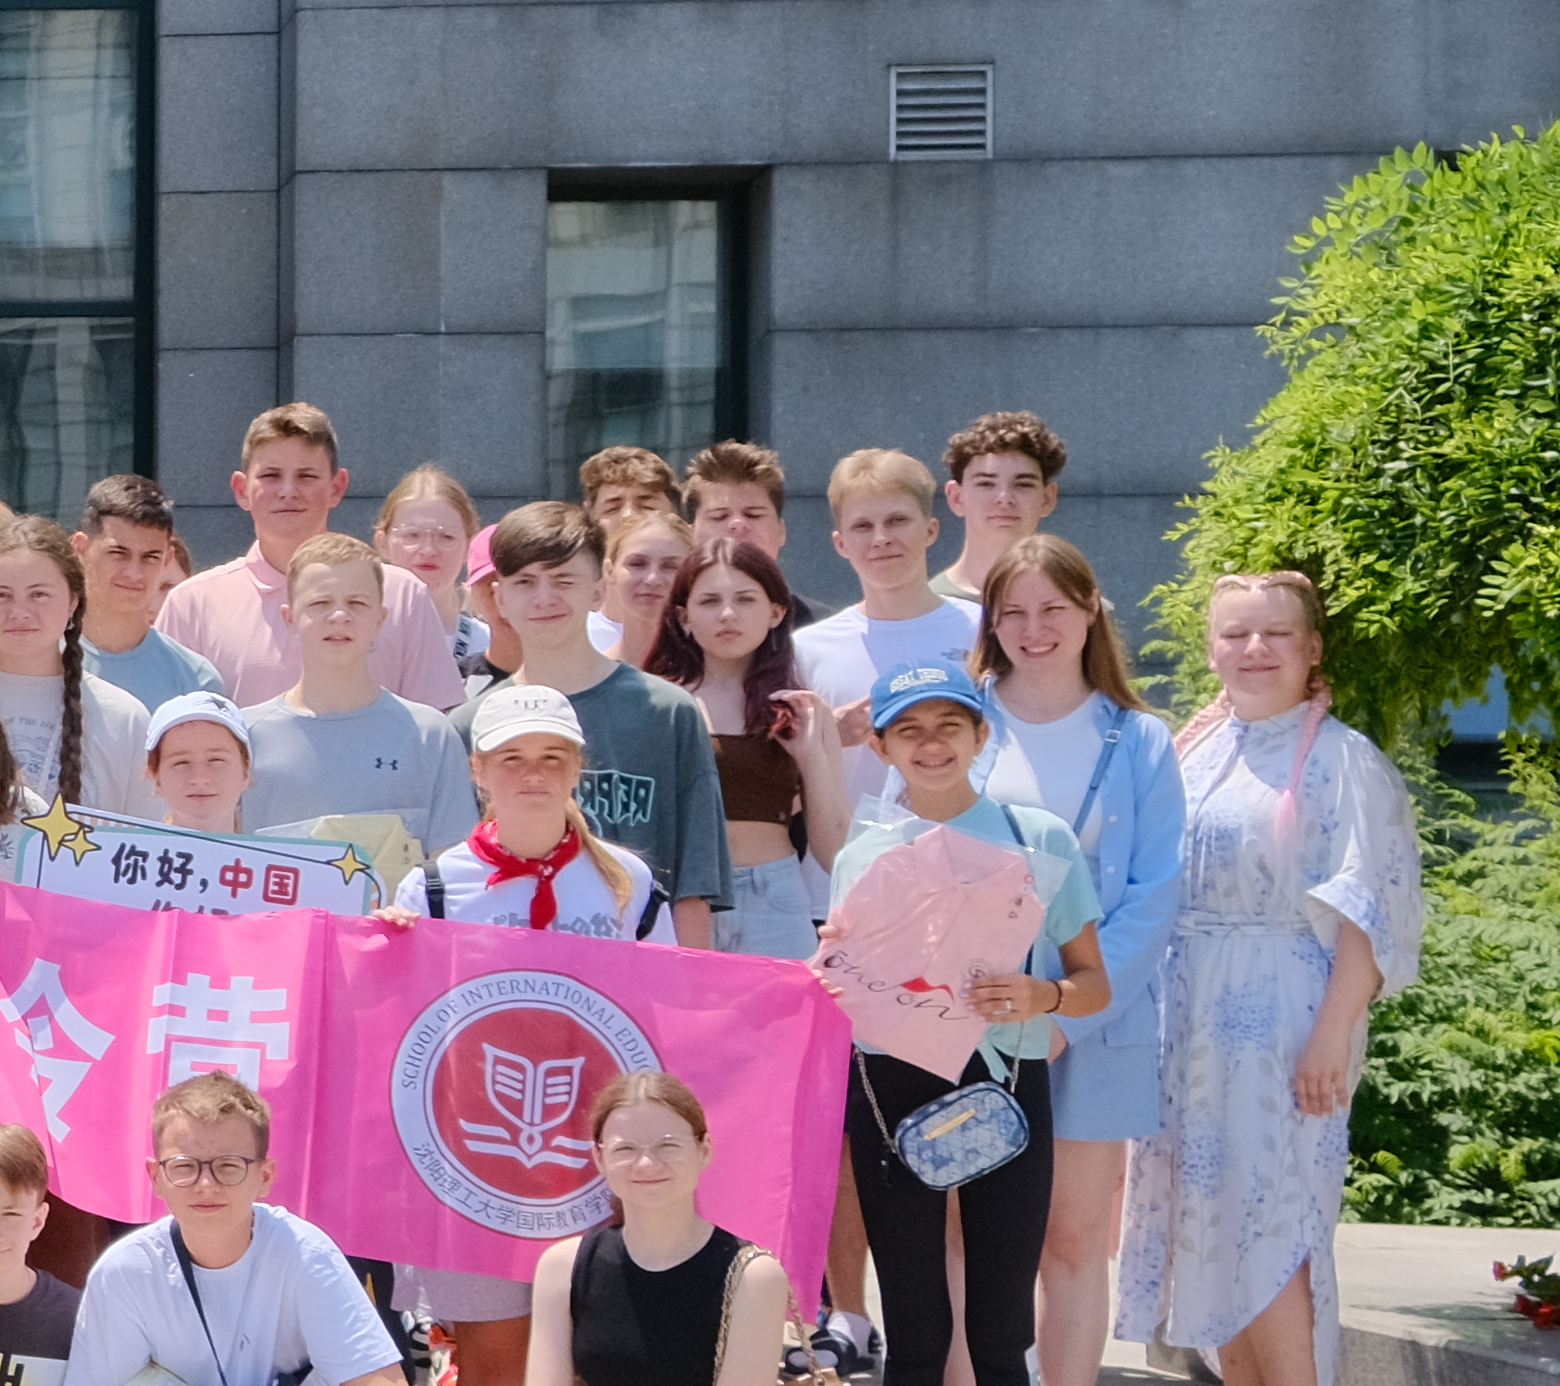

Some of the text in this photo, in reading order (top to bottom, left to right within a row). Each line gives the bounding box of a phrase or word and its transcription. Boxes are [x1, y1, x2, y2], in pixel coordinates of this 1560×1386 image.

[401, 1022, 441, 1090] SCHOOL
[435, 999, 459, 1025] OF
[463, 977, 614, 1031] INTERNATIONAL
